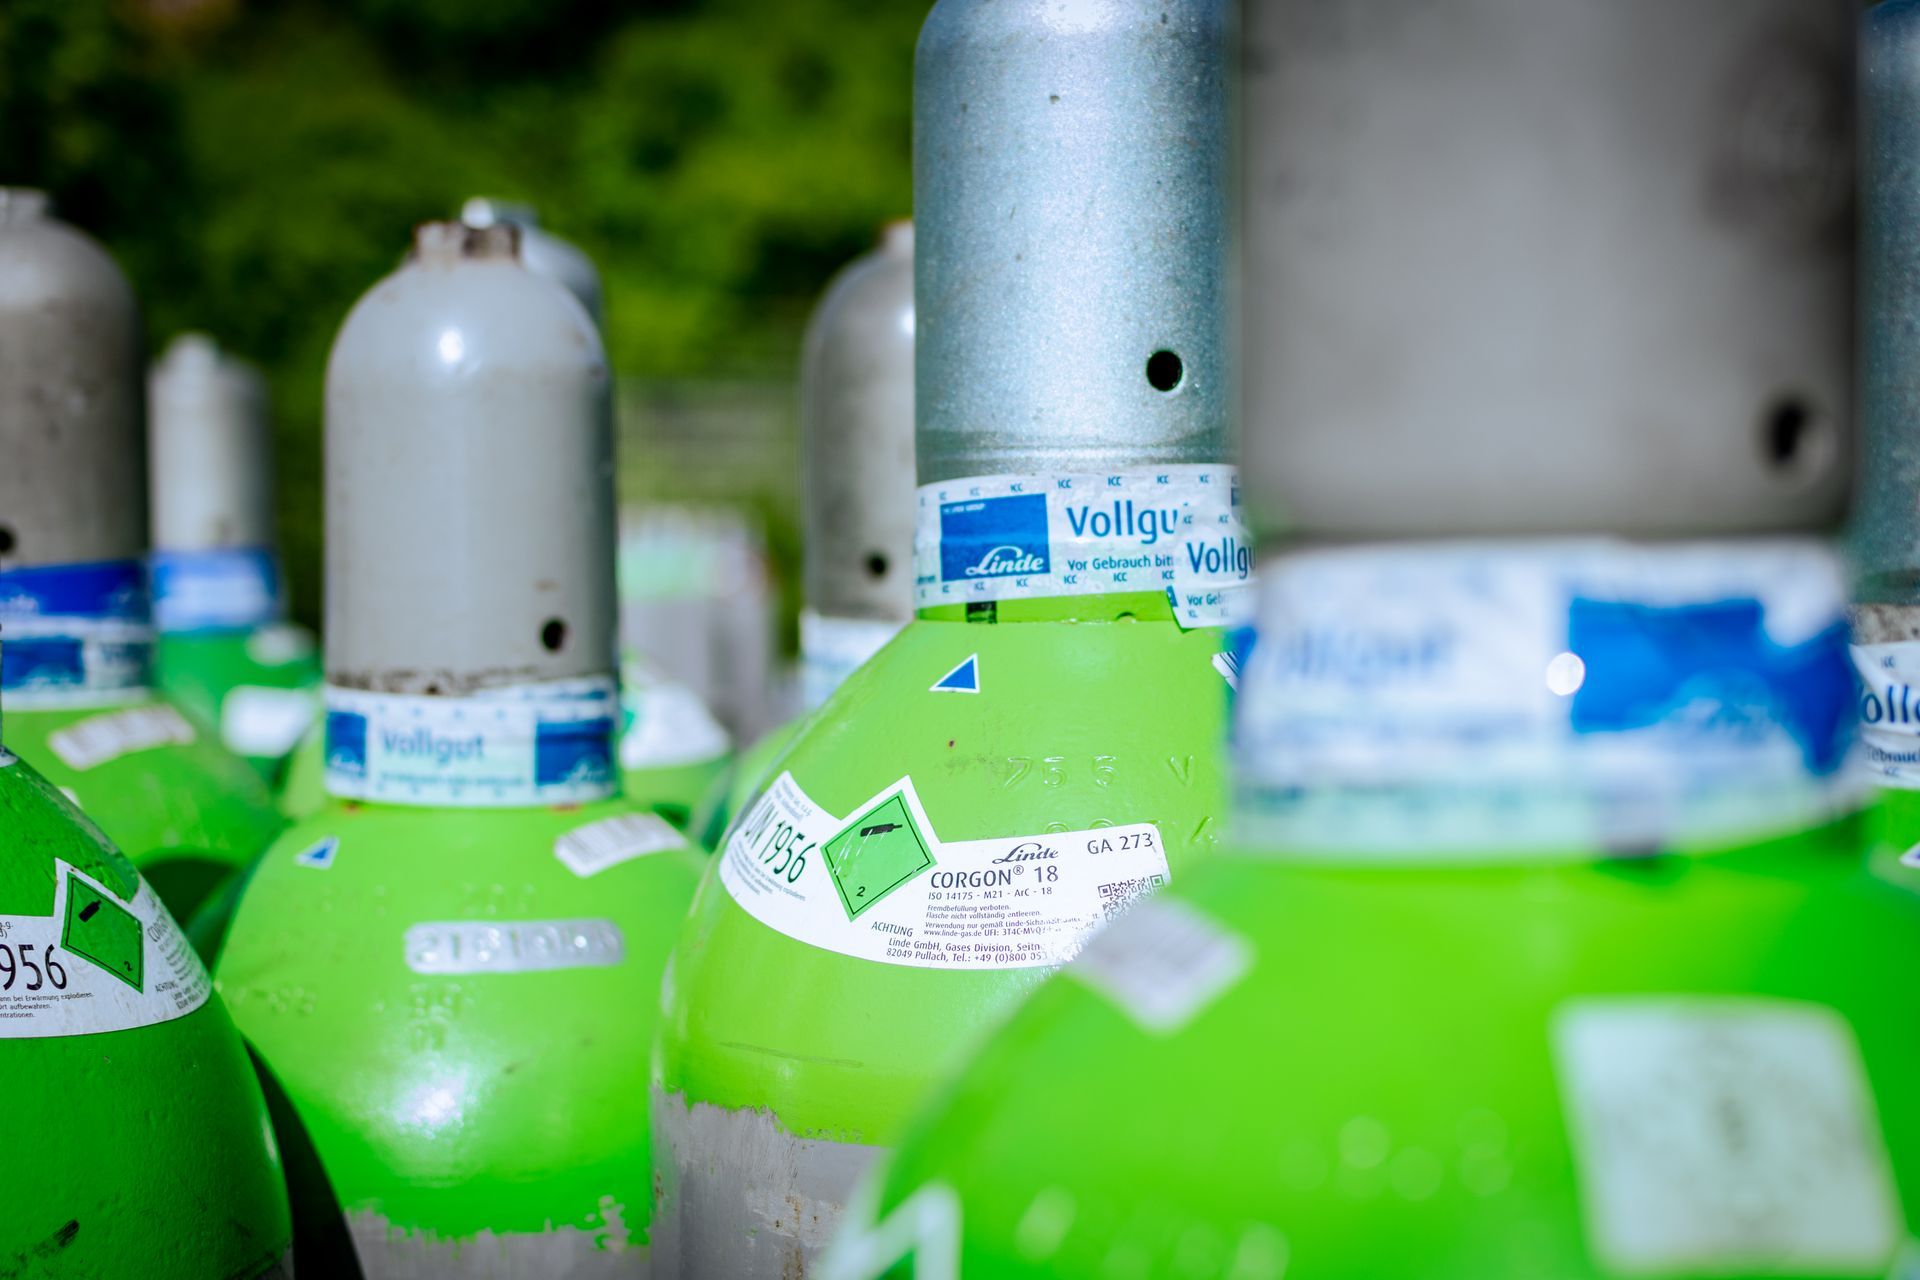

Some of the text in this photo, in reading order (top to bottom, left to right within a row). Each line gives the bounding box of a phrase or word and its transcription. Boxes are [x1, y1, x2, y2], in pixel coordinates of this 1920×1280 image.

[1057, 479, 1072, 489] ICC
[1107, 476, 1122, 487] ICC
[1156, 474, 1169, 485] ICC
[1066, 500, 1178, 545] Vollgu
[965, 545, 1045, 577] Linde
[1067, 559, 1088, 571] Vor
[1092, 555, 1151, 570] Gebrauch
[1063, 574, 1078, 585] ICC
[1113, 572, 1128, 582] ICC
[1161, 570, 1175, 580] ICC
[1087, 832, 1154, 855] GA 273
[758, 820, 817, 884] 1956
[992, 842, 1059, 865] Linde
[1034, 865, 1059, 883] 18
[856, 886, 866, 897] 2
[928, 892, 943, 901] ISO
[946, 891, 973, 900] 14175
[983, 889, 1003, 899] M21
[1014, 887, 1030, 897] ArC
[1042, 886, 1053, 895] 18
[926, 911, 949, 919] Flasche
[969, 911, 1005, 920] vollständig
[871, 921, 914, 938] ACHTUNG
[924, 929, 982, 939] www.linde-gas.de
[925, 921, 965, 931] Verwendung
[889, 937, 911, 948] Linde
[914, 940, 943, 952] GmbH,
[945, 942, 971, 952] Gases
[974, 943, 1013, 953] Division,
[886, 947, 913, 958] 82049
[915, 951, 949, 963] Pullach,
[953, 953, 971, 962] Tel.:
[975, 953, 992, 962] +49
[994, 952, 1027, 964] (0)800
[124, 960, 133, 972] 2
